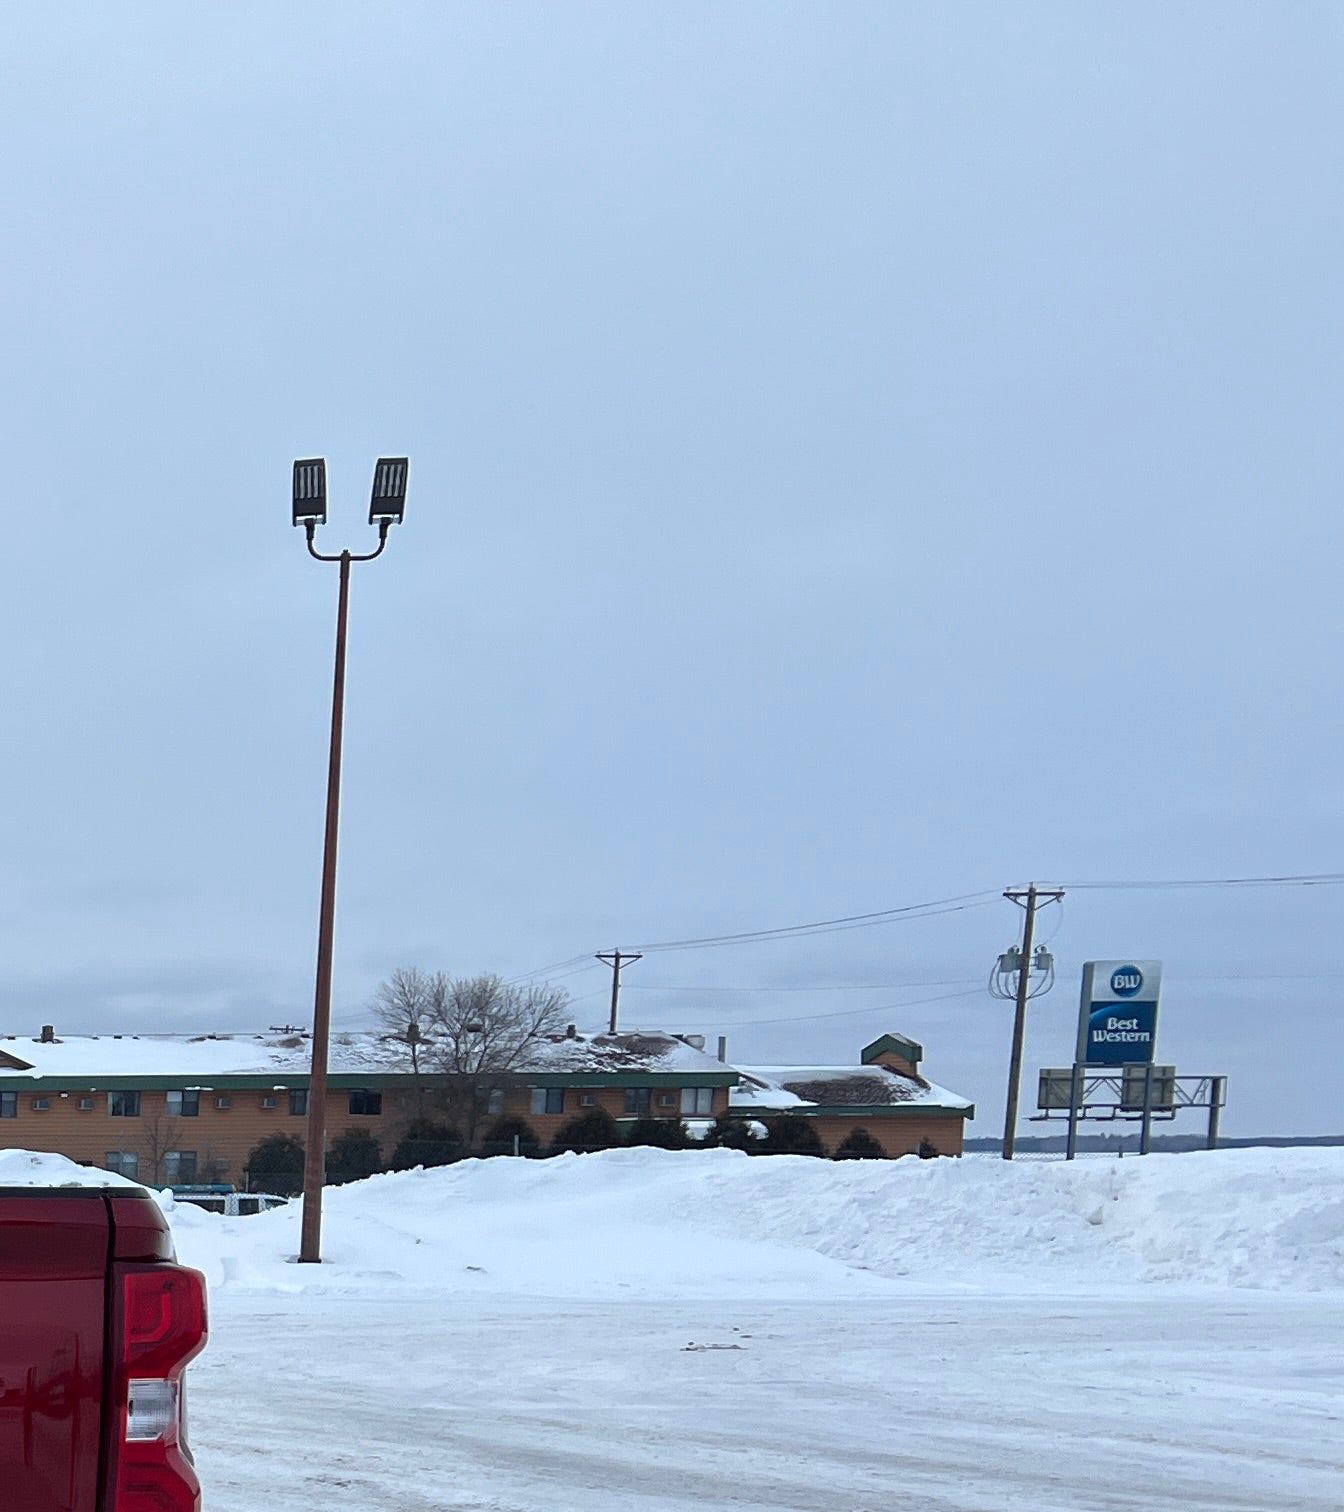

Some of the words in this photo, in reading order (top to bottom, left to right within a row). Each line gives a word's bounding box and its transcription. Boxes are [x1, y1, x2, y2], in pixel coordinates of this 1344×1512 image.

[1114, 975, 1141, 989] BW
[1106, 1017, 1139, 1030] Best
[1092, 1029, 1151, 1042] Western
